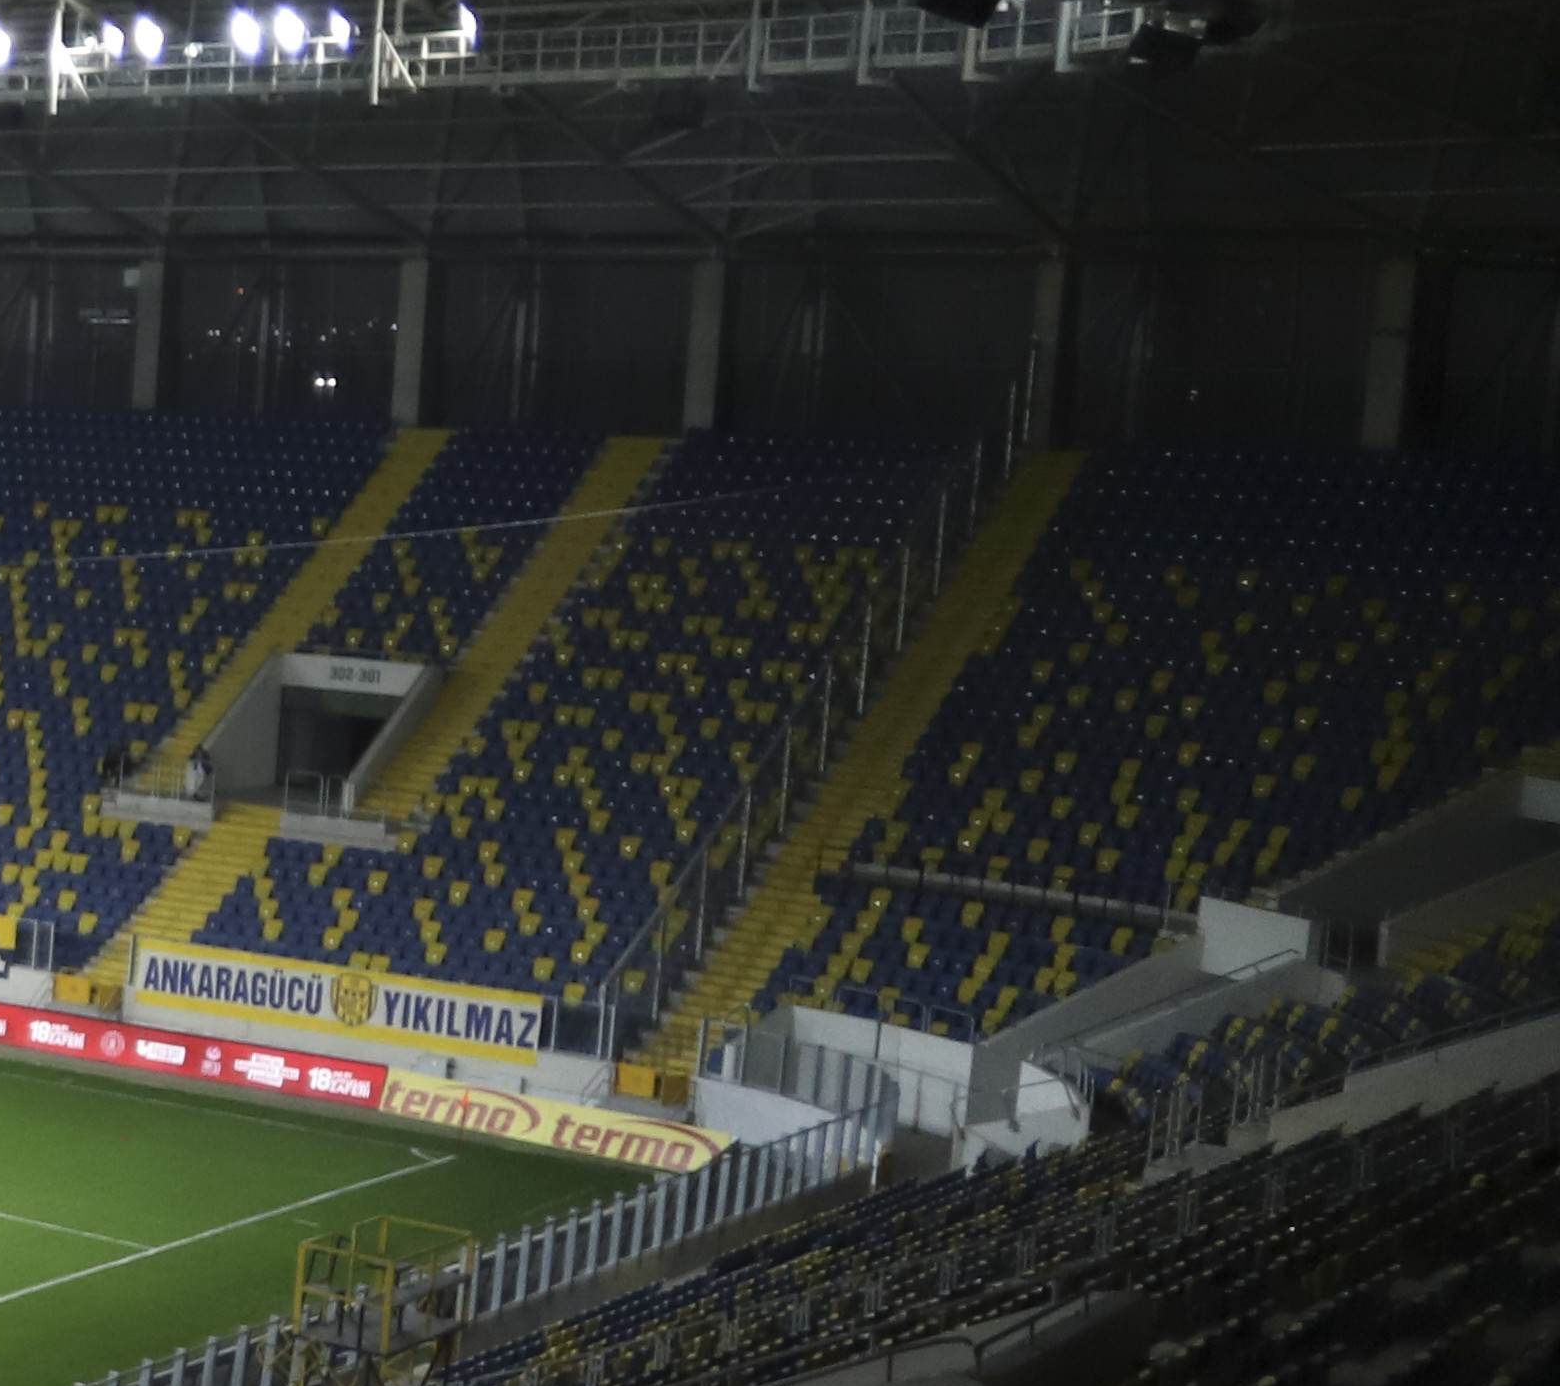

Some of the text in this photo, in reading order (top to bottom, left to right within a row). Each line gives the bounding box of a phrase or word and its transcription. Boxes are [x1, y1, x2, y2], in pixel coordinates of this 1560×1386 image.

[143, 956, 539, 1052] ANKARAGÜCÜ YIKILMAZ
[29, 1020, 50, 1043] 18
[309, 1066, 331, 1091] 18
